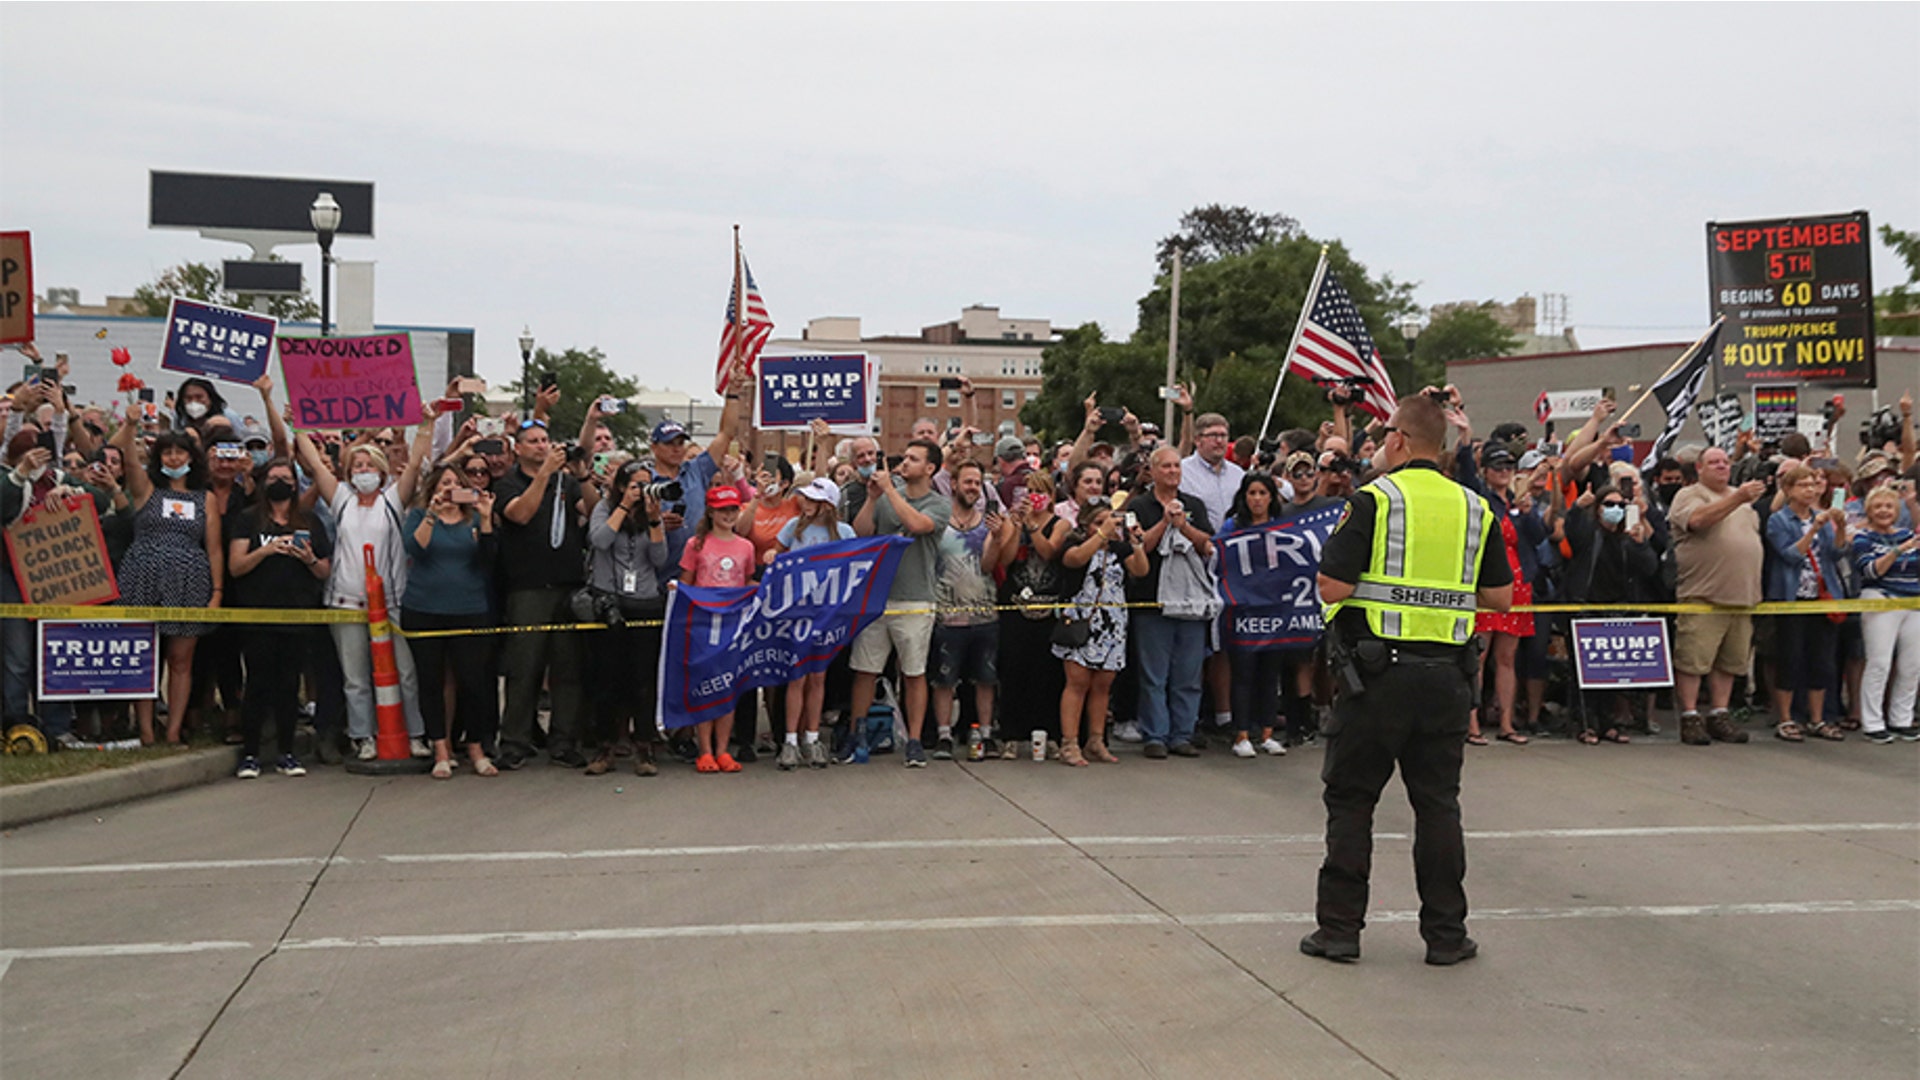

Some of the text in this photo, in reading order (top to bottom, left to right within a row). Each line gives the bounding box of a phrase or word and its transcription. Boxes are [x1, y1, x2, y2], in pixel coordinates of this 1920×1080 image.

[1715, 222, 1861, 252] SEPTEMBER
[1720, 282, 1860, 307] BEGINS 60 DAYS
[1792, 308, 1802, 317] TO
[175, 317, 268, 349] TRUMP
[1743, 321, 1838, 338] TRUMP/PENCE
[179, 335, 257, 360] PENCE
[280, 338, 402, 358] DENOUNCED
[1723, 338, 1865, 367] #OUT NOW!
[310, 360, 360, 378] ALL
[764, 372, 861, 389] TRUMP
[773, 389, 852, 400] PENCE
[298, 392, 407, 425] BIDEN
[18, 516, 82, 547] TRUMP
[24, 533, 95, 567] GO BACK
[28, 552, 100, 584] WHERE U
[30, 580, 71, 604] CAME
[1390, 587, 1466, 606] SHERIFF
[1235, 617, 1283, 633] KEEP
[47, 640, 150, 655] TRUMP
[1580, 636, 1661, 650] TRUMP
[56, 657, 141, 667] PENCE
[736, 649, 800, 678] AMERICA
[1588, 651, 1655, 660] PENCE
